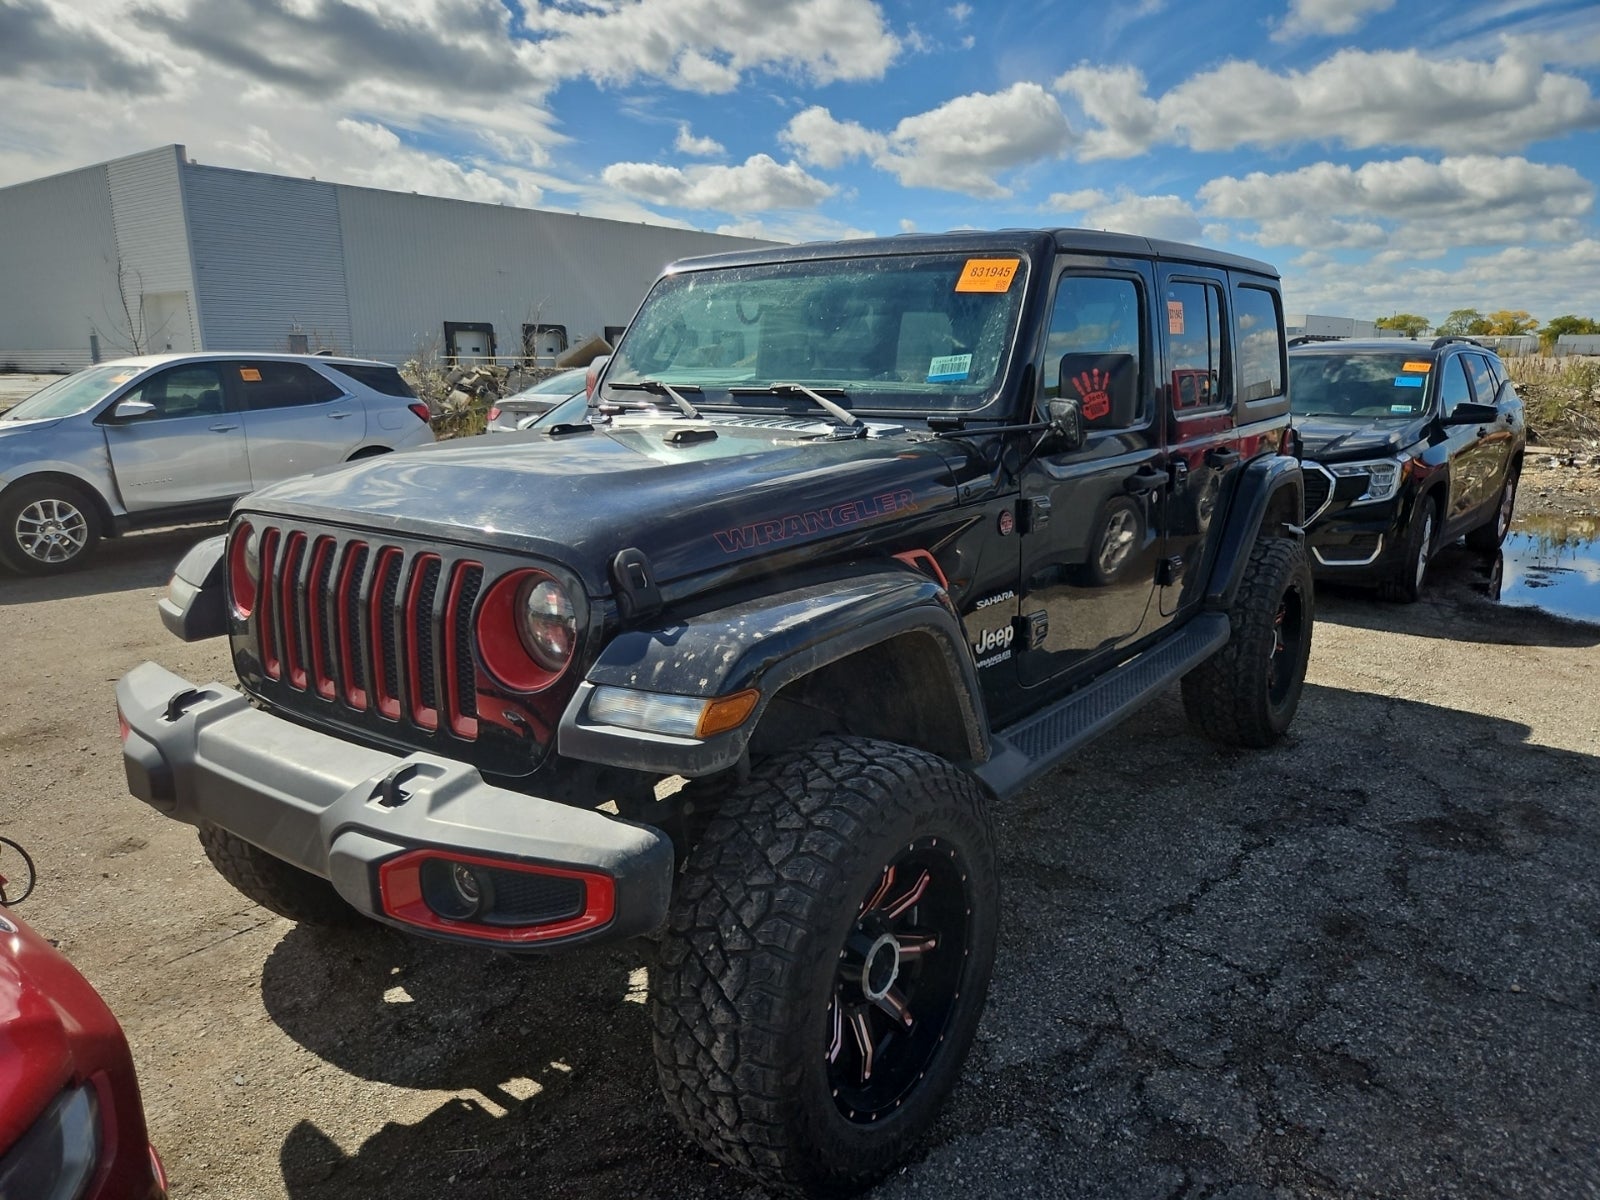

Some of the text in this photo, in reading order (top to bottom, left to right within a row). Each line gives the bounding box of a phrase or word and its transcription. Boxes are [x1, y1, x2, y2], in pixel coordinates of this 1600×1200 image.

[970, 266, 1012, 277] 831945
[713, 489, 918, 553] WRANGLER
[976, 590, 1015, 610] SAHARA
[975, 625, 1014, 655] Jeep
